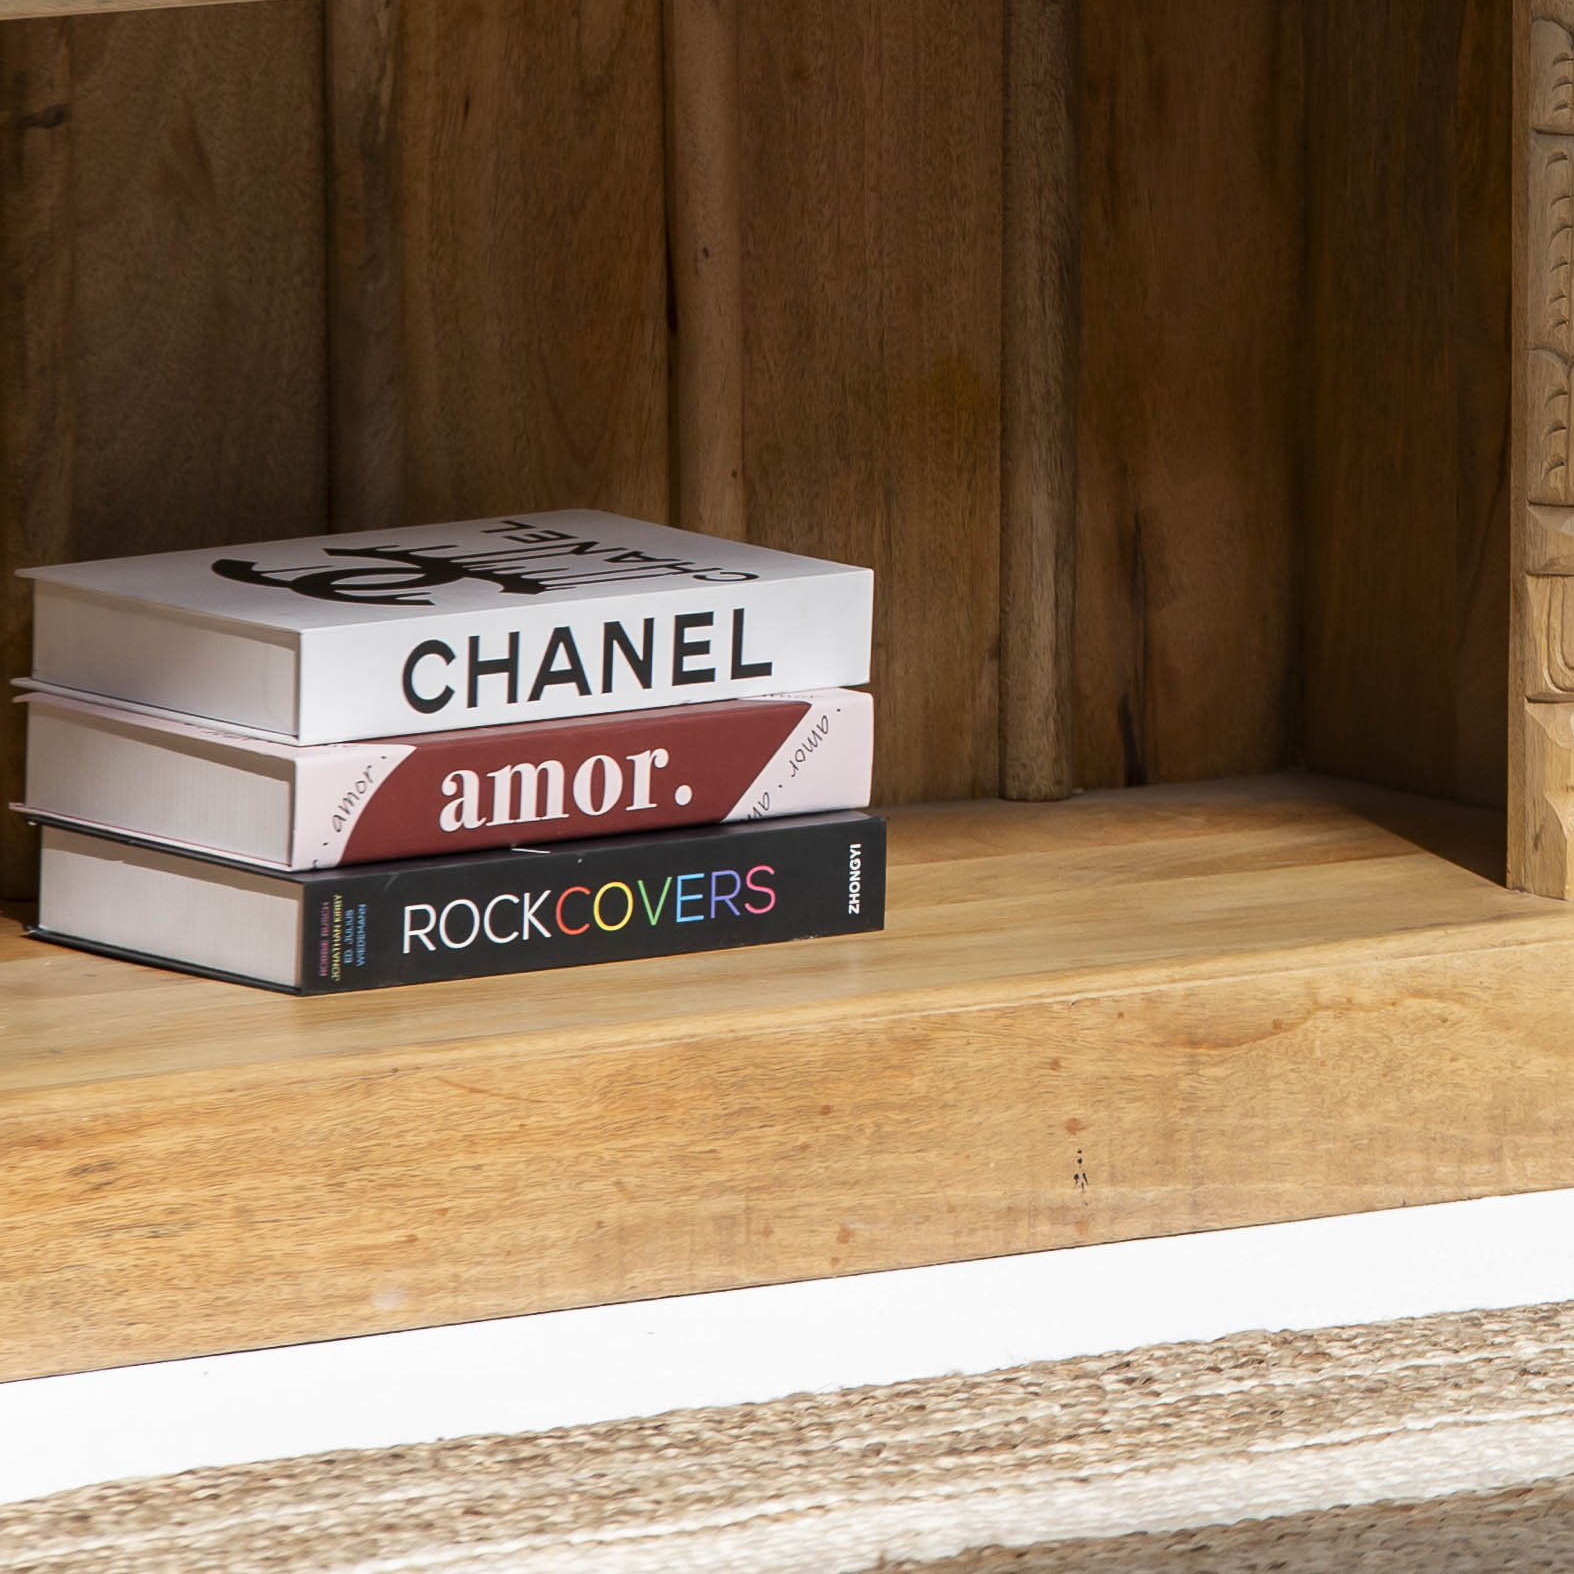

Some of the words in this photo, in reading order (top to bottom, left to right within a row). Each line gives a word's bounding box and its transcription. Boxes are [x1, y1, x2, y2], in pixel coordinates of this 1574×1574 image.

[481, 520, 760, 582] CHANEL
[402, 608, 773, 715] CHANEL
[789, 715, 829, 778] amor
[331, 765, 374, 833] amor
[439, 747, 693, 832] amor.
[848, 843, 862, 915] ZHONGYI
[331, 924, 342, 982] JONATHAN
[344, 909, 354, 945] JULIUS
[356, 903, 367, 967] WIEDEMANN
